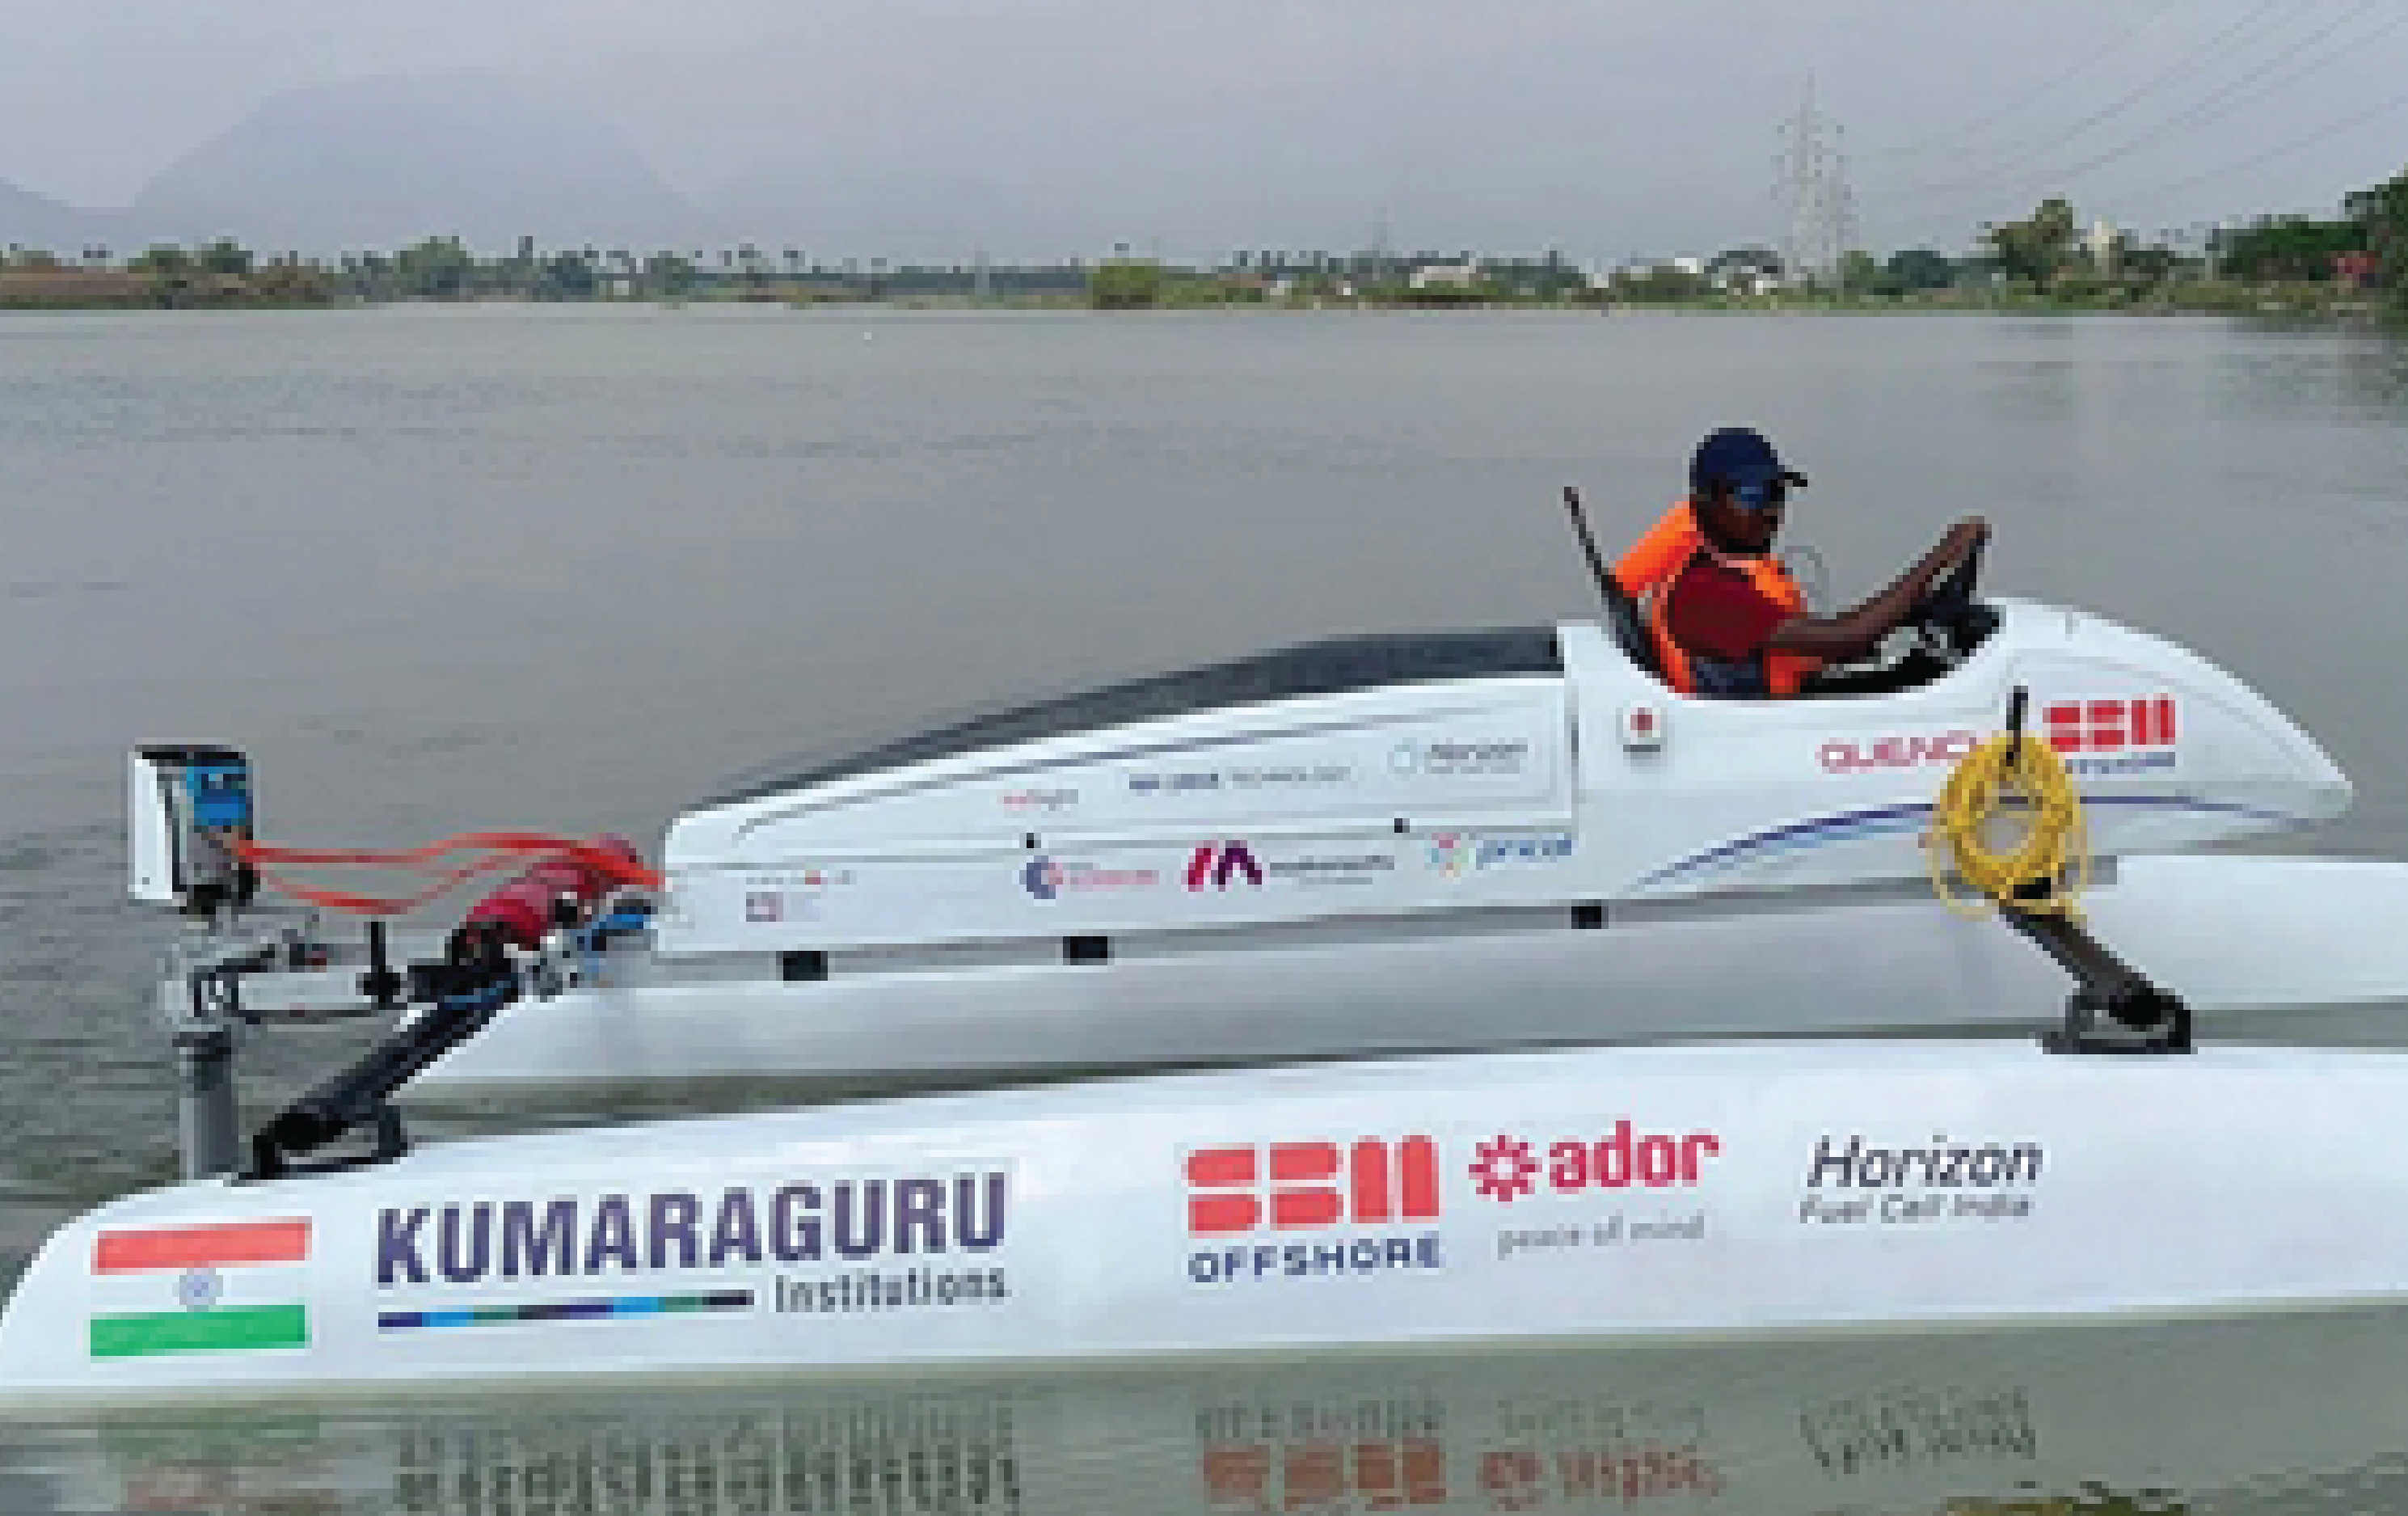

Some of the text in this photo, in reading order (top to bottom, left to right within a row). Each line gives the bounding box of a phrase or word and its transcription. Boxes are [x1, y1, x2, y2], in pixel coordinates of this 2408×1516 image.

[1185, 1134, 1440, 1233] SBM
[1549, 1120, 1721, 1192] ador
[1806, 1132, 2043, 1187] Horizon
[376, 1172, 1006, 1284] KUMARAGURU
[1498, 1211, 1706, 1261] peace of mind
[1187, 1235, 1443, 1284] OFFSHORE
[774, 1265, 1006, 1314] Institutions
